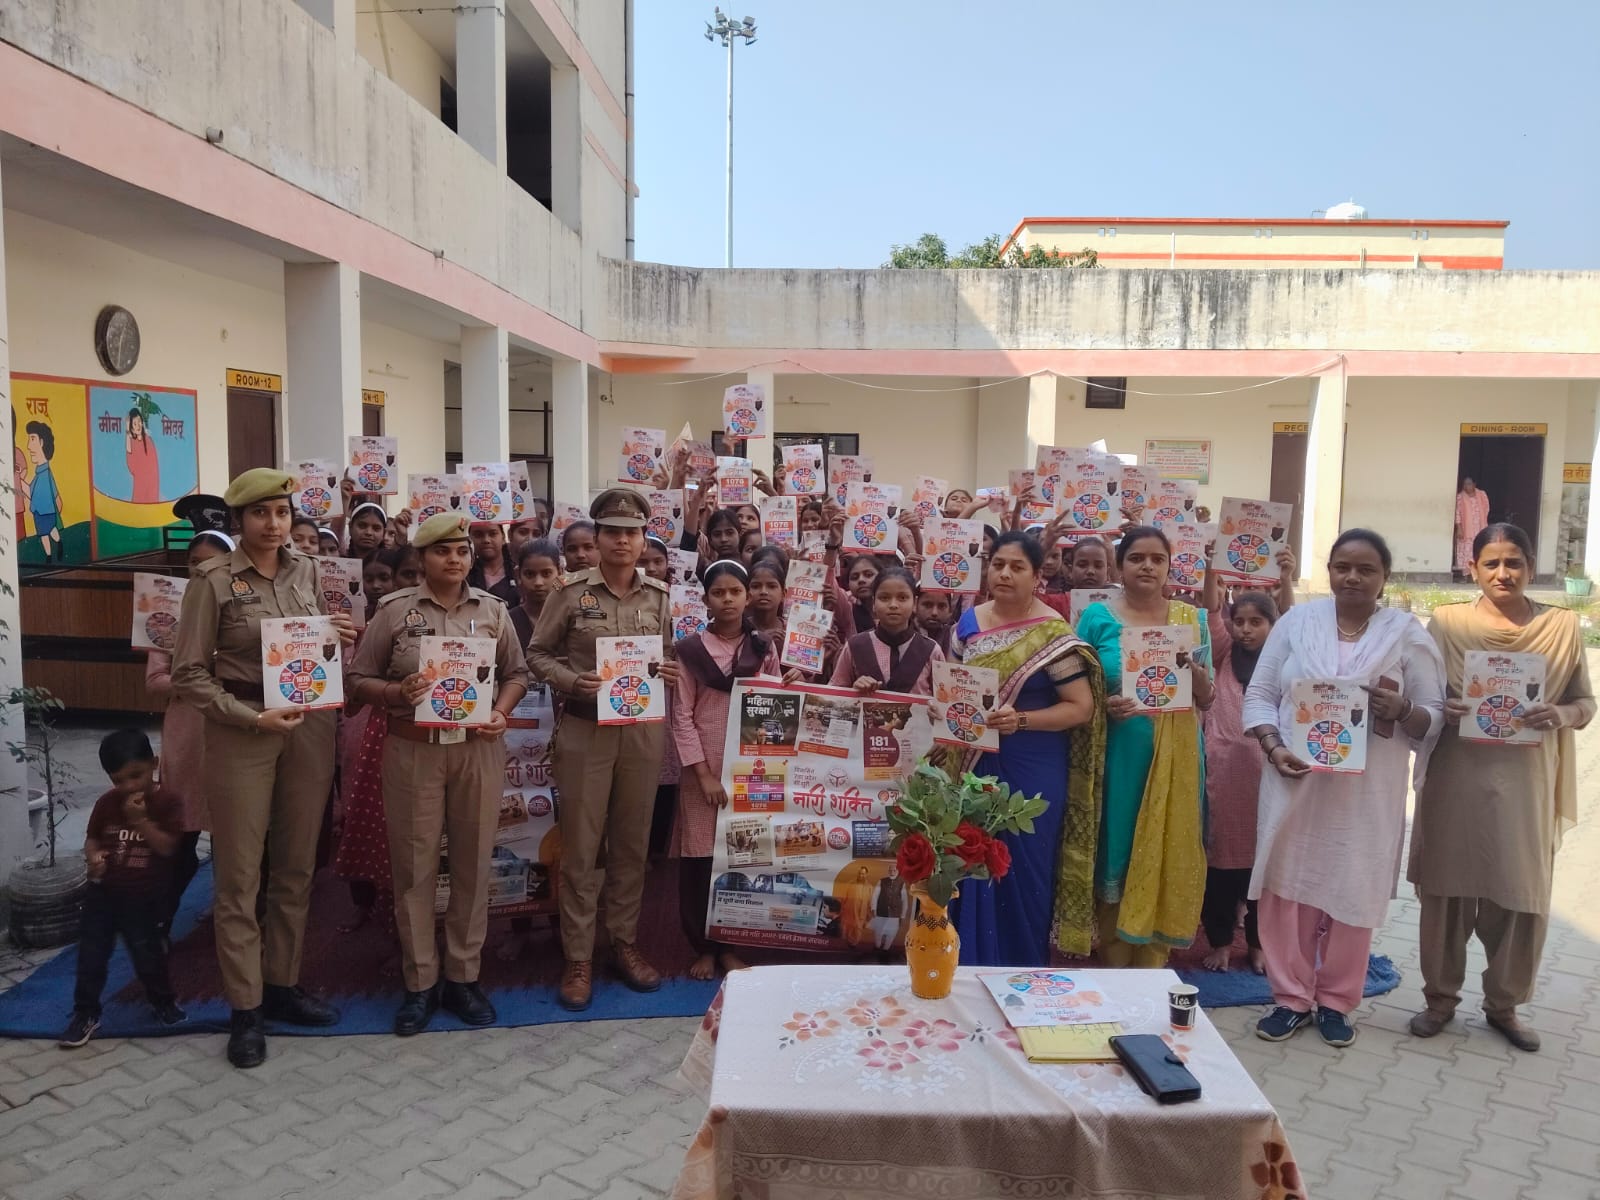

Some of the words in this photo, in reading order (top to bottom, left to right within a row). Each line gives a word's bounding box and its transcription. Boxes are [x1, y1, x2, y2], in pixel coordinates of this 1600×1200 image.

[236, 374, 272, 389] ROOM-12
[26, 397, 53, 423] राजू
[98, 410, 122, 433] मीना
[1283, 424, 1310, 432] RECE
[1470, 425, 1503, 433] DINING
[1511, 425, 1536, 433] ROOM
[792, 588, 814, 597] 1076
[795, 633, 817, 646] 1076
[746, 695, 774, 706] महिला
[746, 706, 771, 717] सुरक्षा
[869, 736, 889, 747] 181
[793, 783, 827, 816] नारी
[830, 786, 882, 822] शक्ति
[1173, 994, 1191, 1005] Tea
